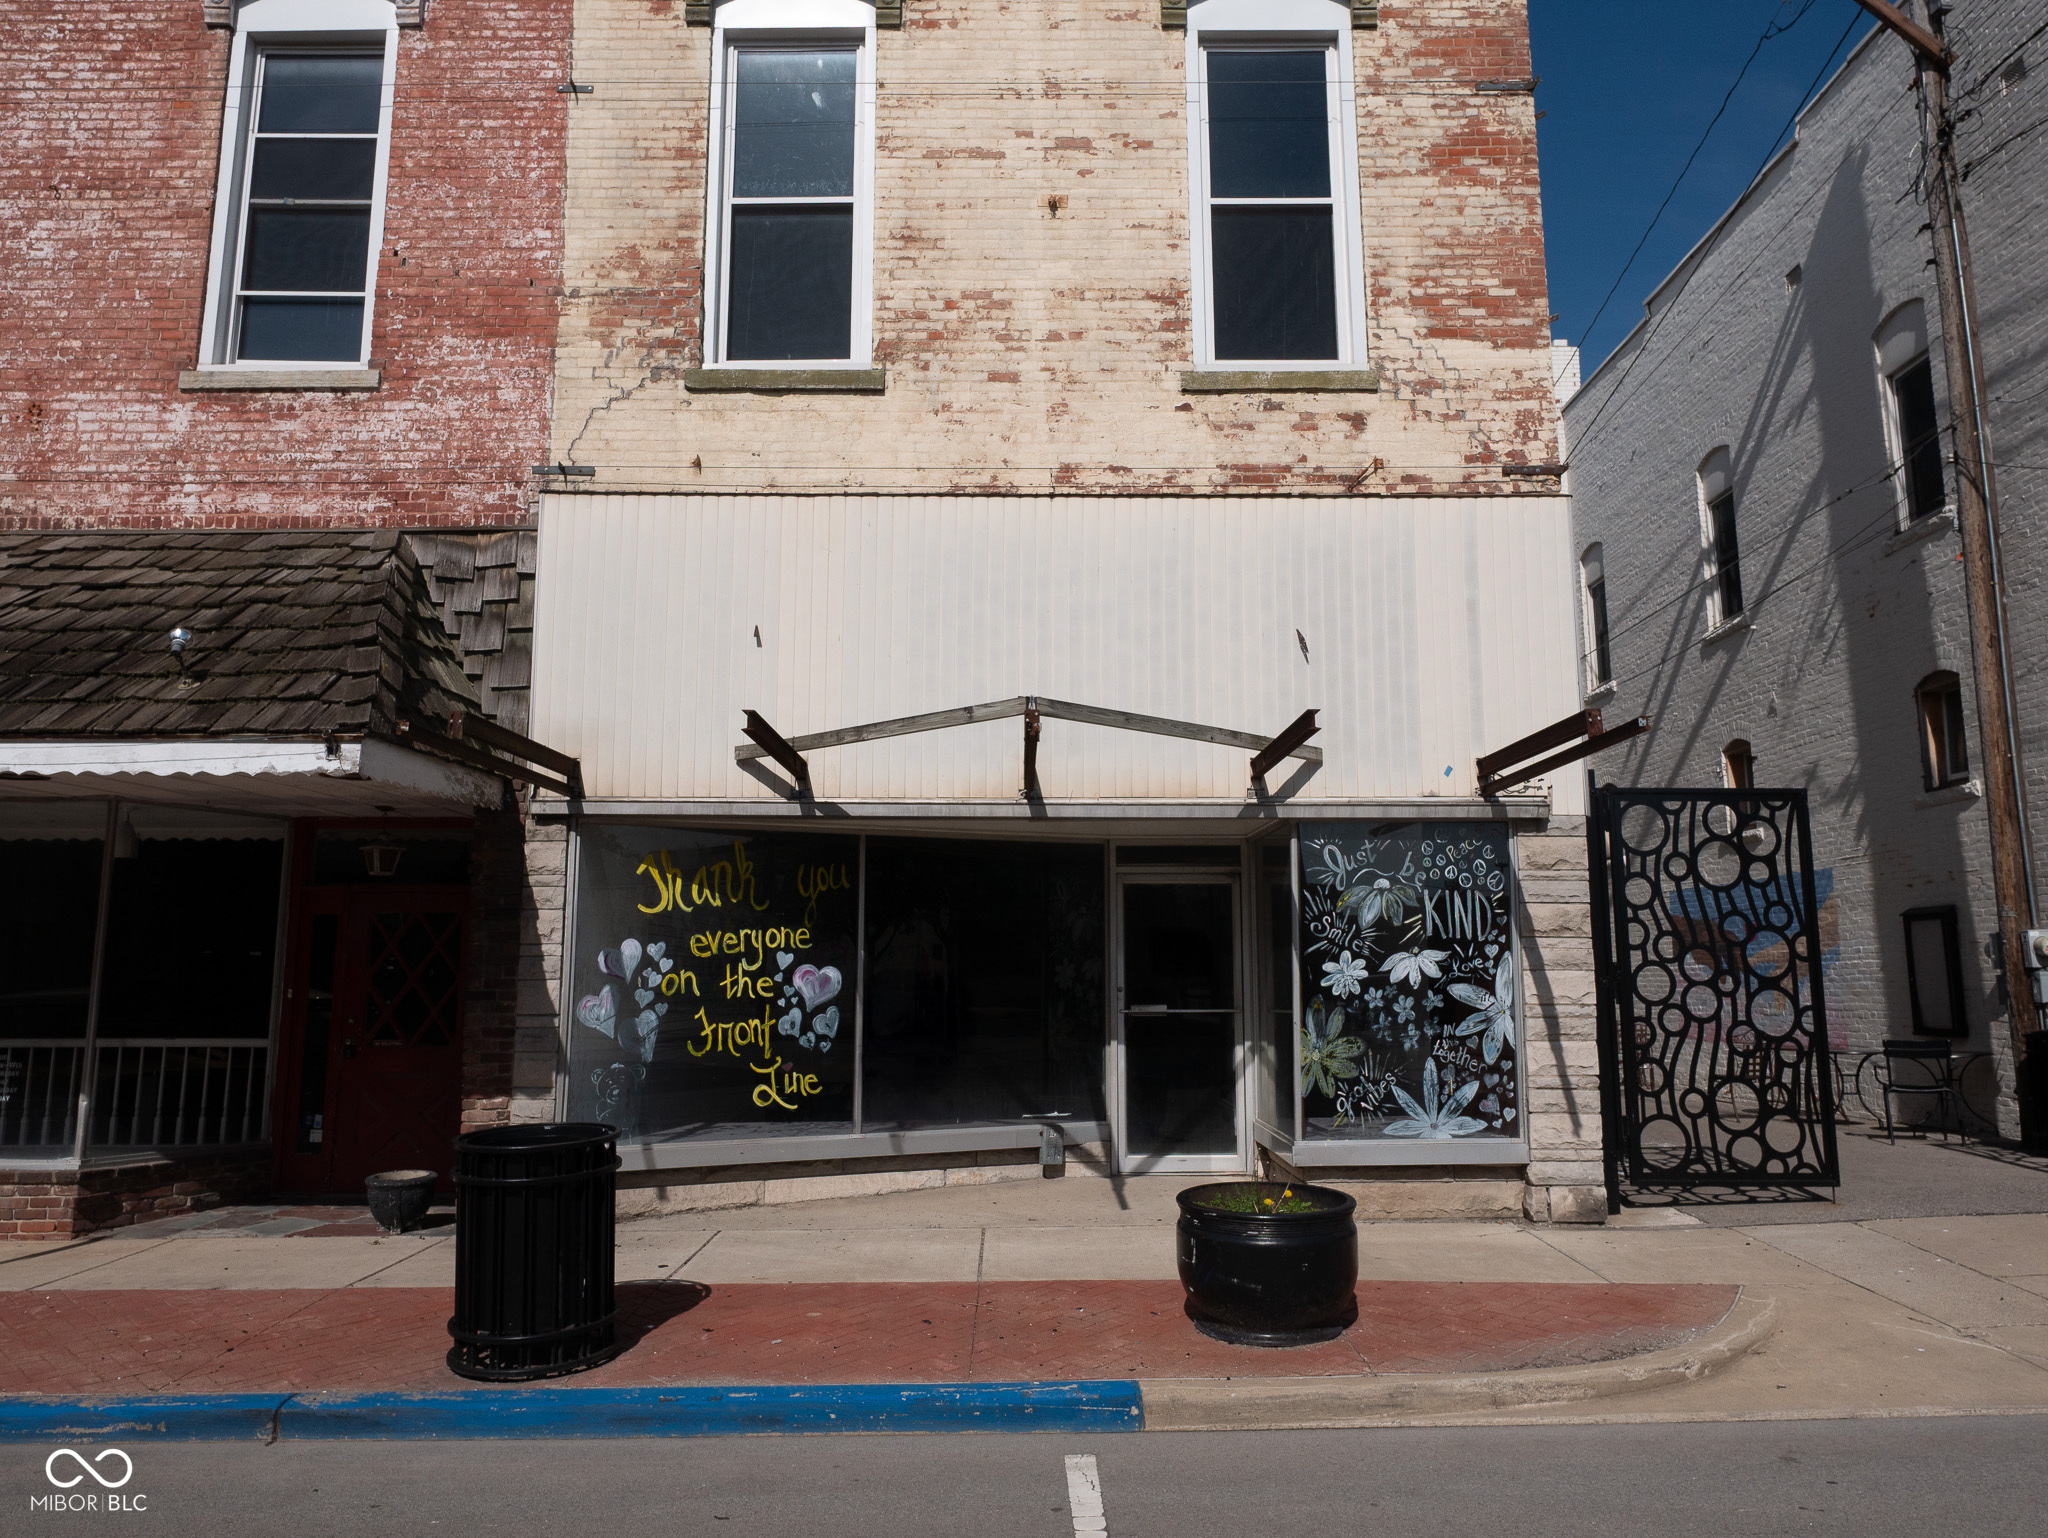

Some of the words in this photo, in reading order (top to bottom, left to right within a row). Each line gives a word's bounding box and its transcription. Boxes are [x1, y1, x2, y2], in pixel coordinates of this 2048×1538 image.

[636, 840, 770, 913] Thank
[797, 862, 850, 928] you
[1323, 839, 1377, 891] Just
[1399, 851, 1427, 887] be
[1310, 916, 1364, 952] Smile
[1423, 888, 1492, 942] KIND
[690, 926, 813, 971] everyone
[1448, 955, 1485, 978] Love
[660, 968, 700, 997] on
[719, 963, 774, 1000] the
[687, 1004, 776, 1059] Front
[1432, 1039, 1488, 1074] together
[750, 1056, 823, 1110] Line
